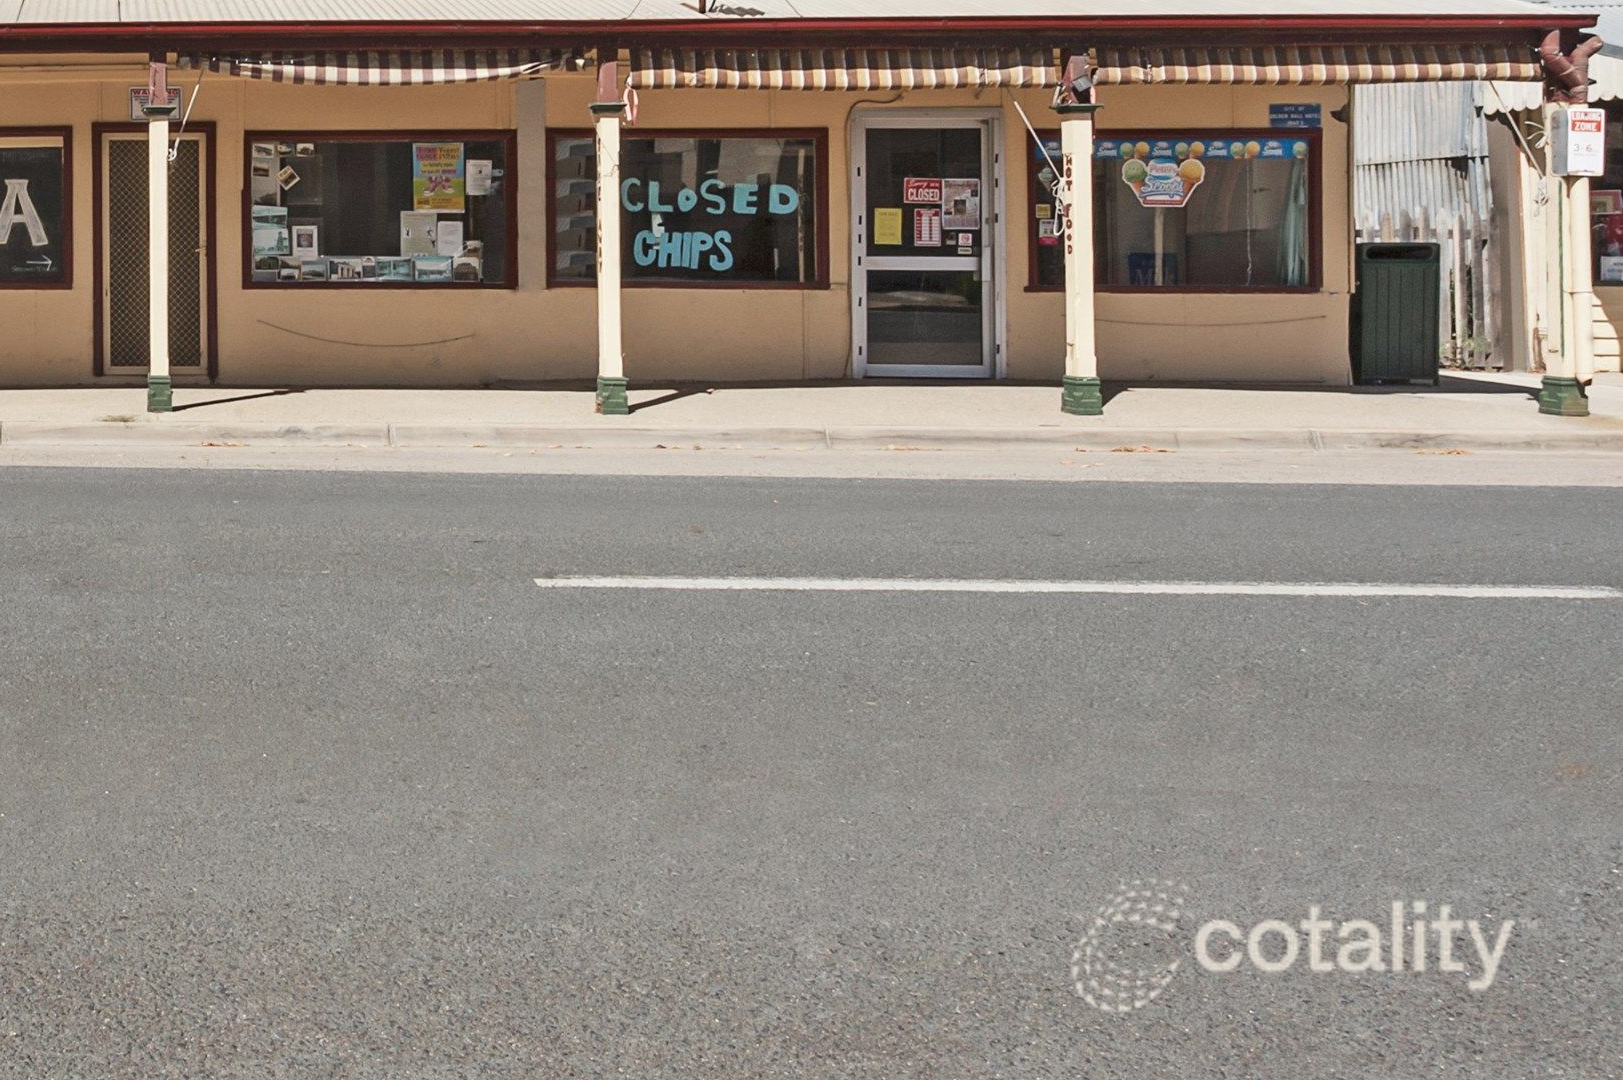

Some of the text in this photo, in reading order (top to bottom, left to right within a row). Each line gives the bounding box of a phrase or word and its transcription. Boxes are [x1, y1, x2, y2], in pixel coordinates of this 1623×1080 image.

[1574, 122, 1597, 131] ZONE
[908, 180, 928, 188] Sorry
[621, 177, 800, 215] CLOSED
[908, 188, 940, 201] CLOSED
[633, 230, 734, 271] CHIPS
